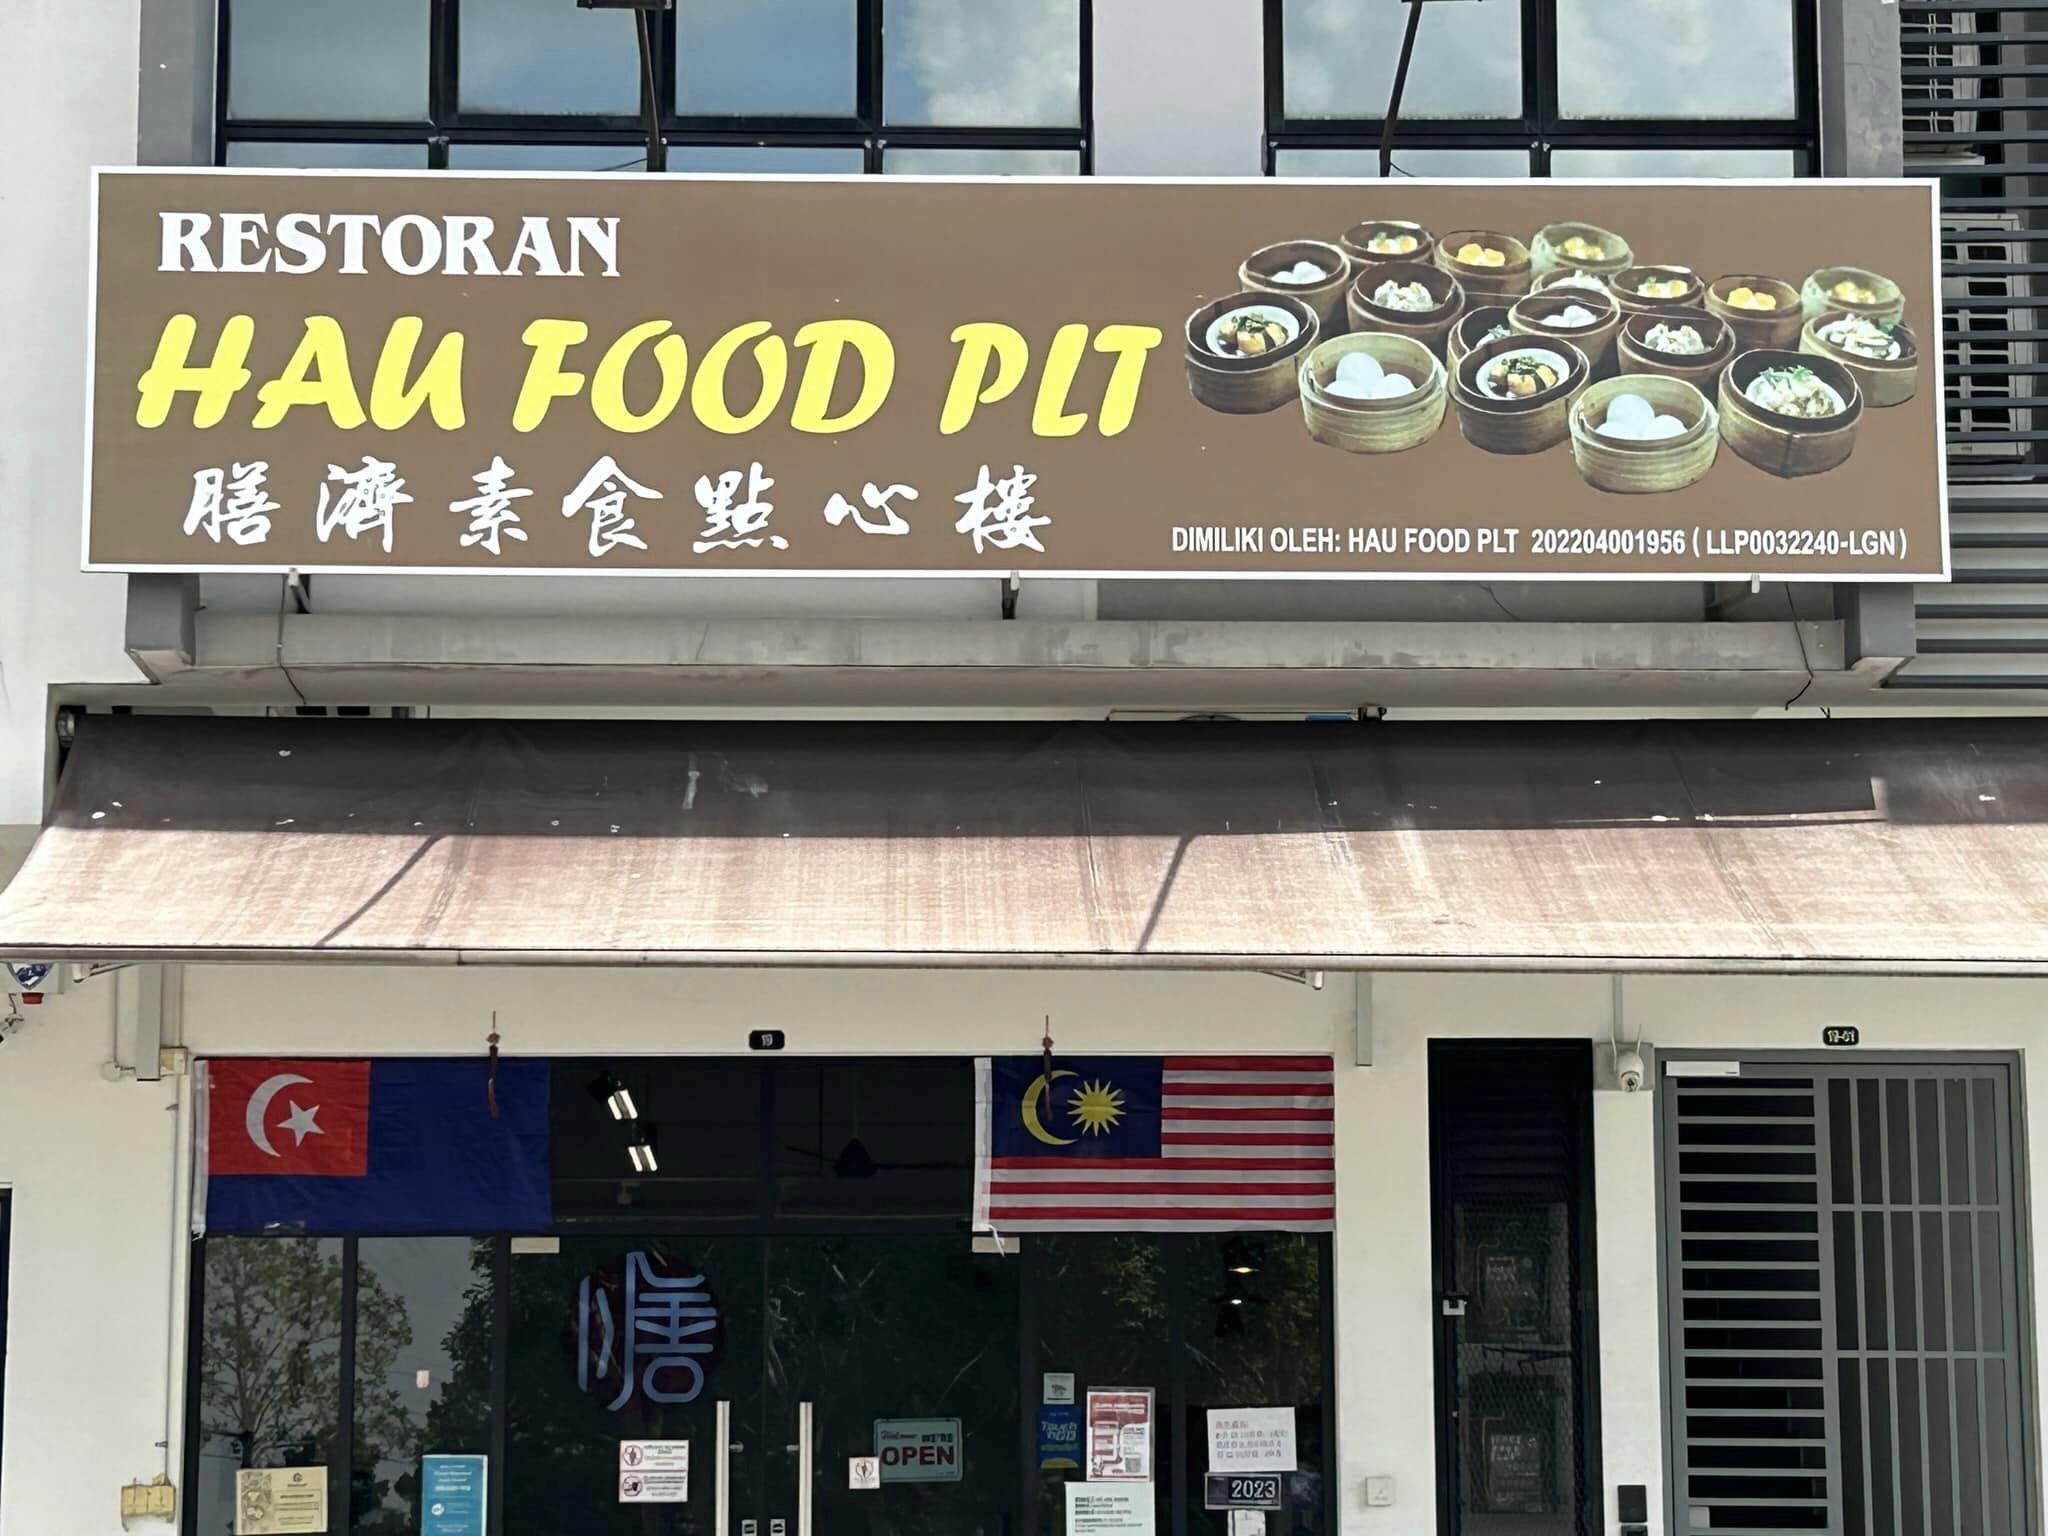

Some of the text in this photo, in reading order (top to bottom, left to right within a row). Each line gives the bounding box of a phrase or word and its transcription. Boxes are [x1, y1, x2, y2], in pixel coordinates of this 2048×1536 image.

[158, 213, 620, 278] RESTORAN
[136, 315, 1161, 437] HAU FOOD PLT
[184, 456, 1051, 557] 膳濟素食點心樓
[1171, 527, 1264, 553] DIMILIKI
[1270, 527, 1341, 553] OLEH:
[1348, 527, 1397, 553] HAU
[1404, 528, 1471, 553] FOOD
[1477, 528, 1520, 553] PLT
[1531, 528, 1686, 555] 202204001956
[879, 1445, 955, 1466] OPEN
[1231, 1480, 1276, 1499] 2023
